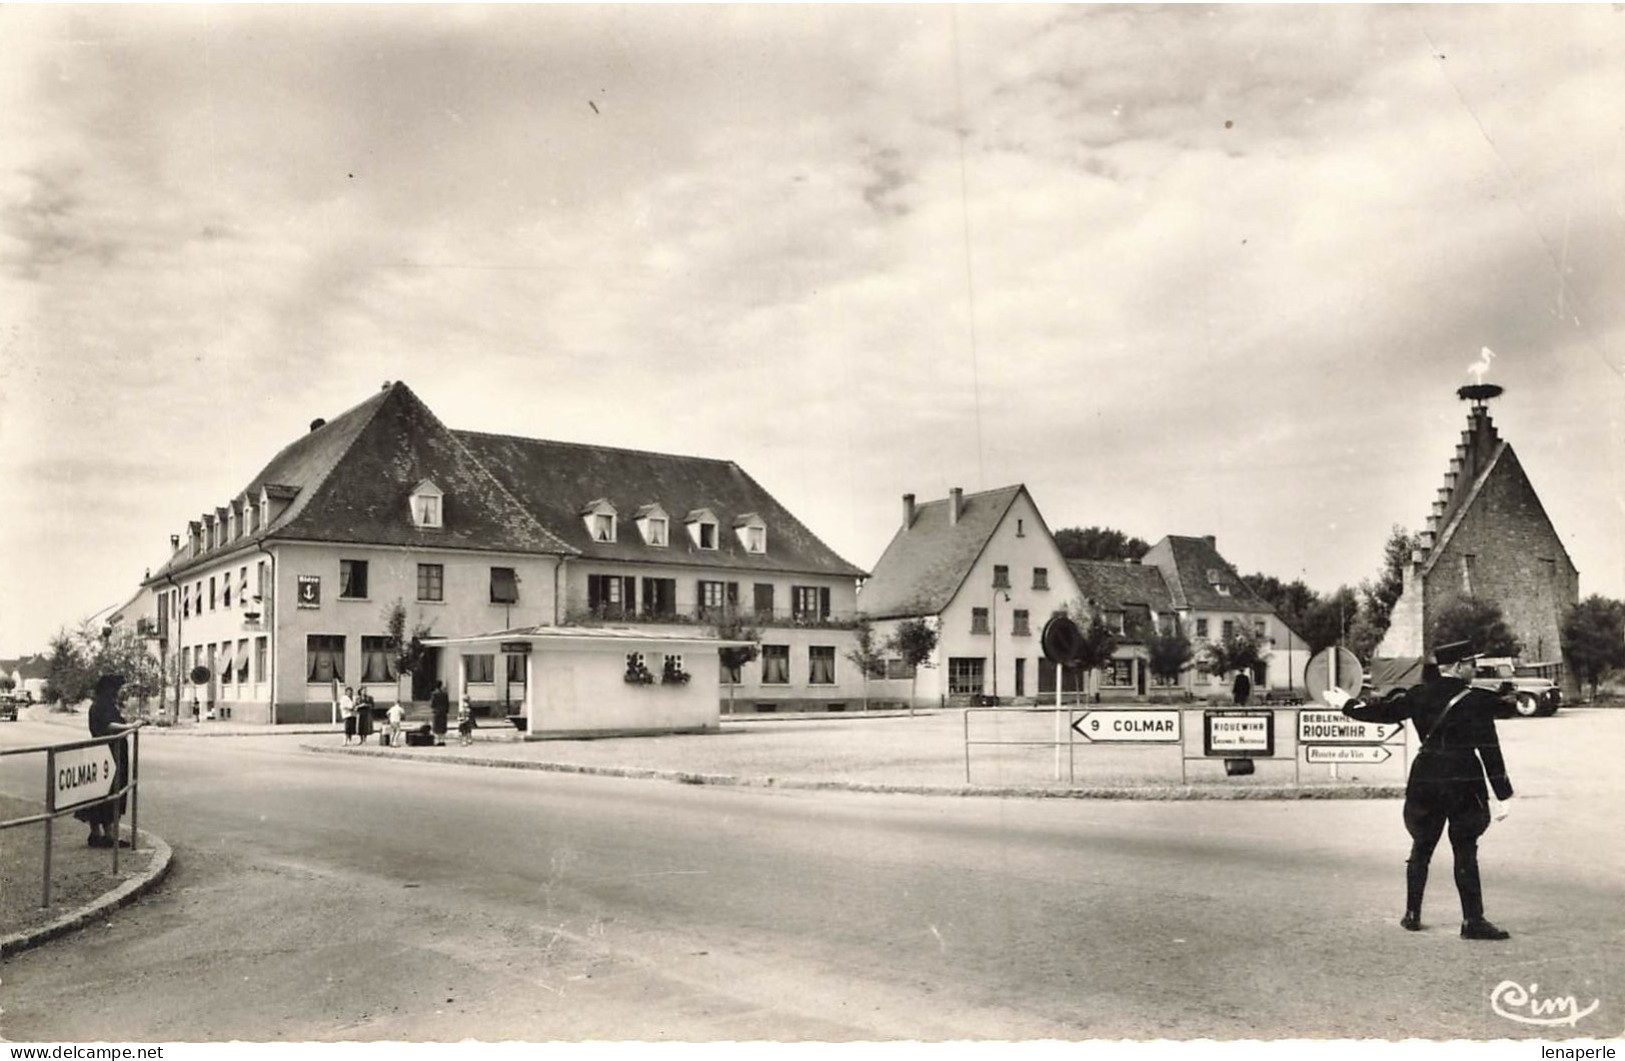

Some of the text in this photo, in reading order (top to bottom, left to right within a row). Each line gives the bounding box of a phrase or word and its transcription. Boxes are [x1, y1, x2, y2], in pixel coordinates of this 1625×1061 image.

[1091, 719, 1174, 732] 9 COLMAR
[1213, 722, 1264, 731] RIQUEWIHR
[1303, 725, 1385, 738] RIQUEWIHR 5
[1310, 749, 1336, 758] Route
[1351, 749, 1364, 758] Vin
[58, 760, 109, 791] COLMAR 9
